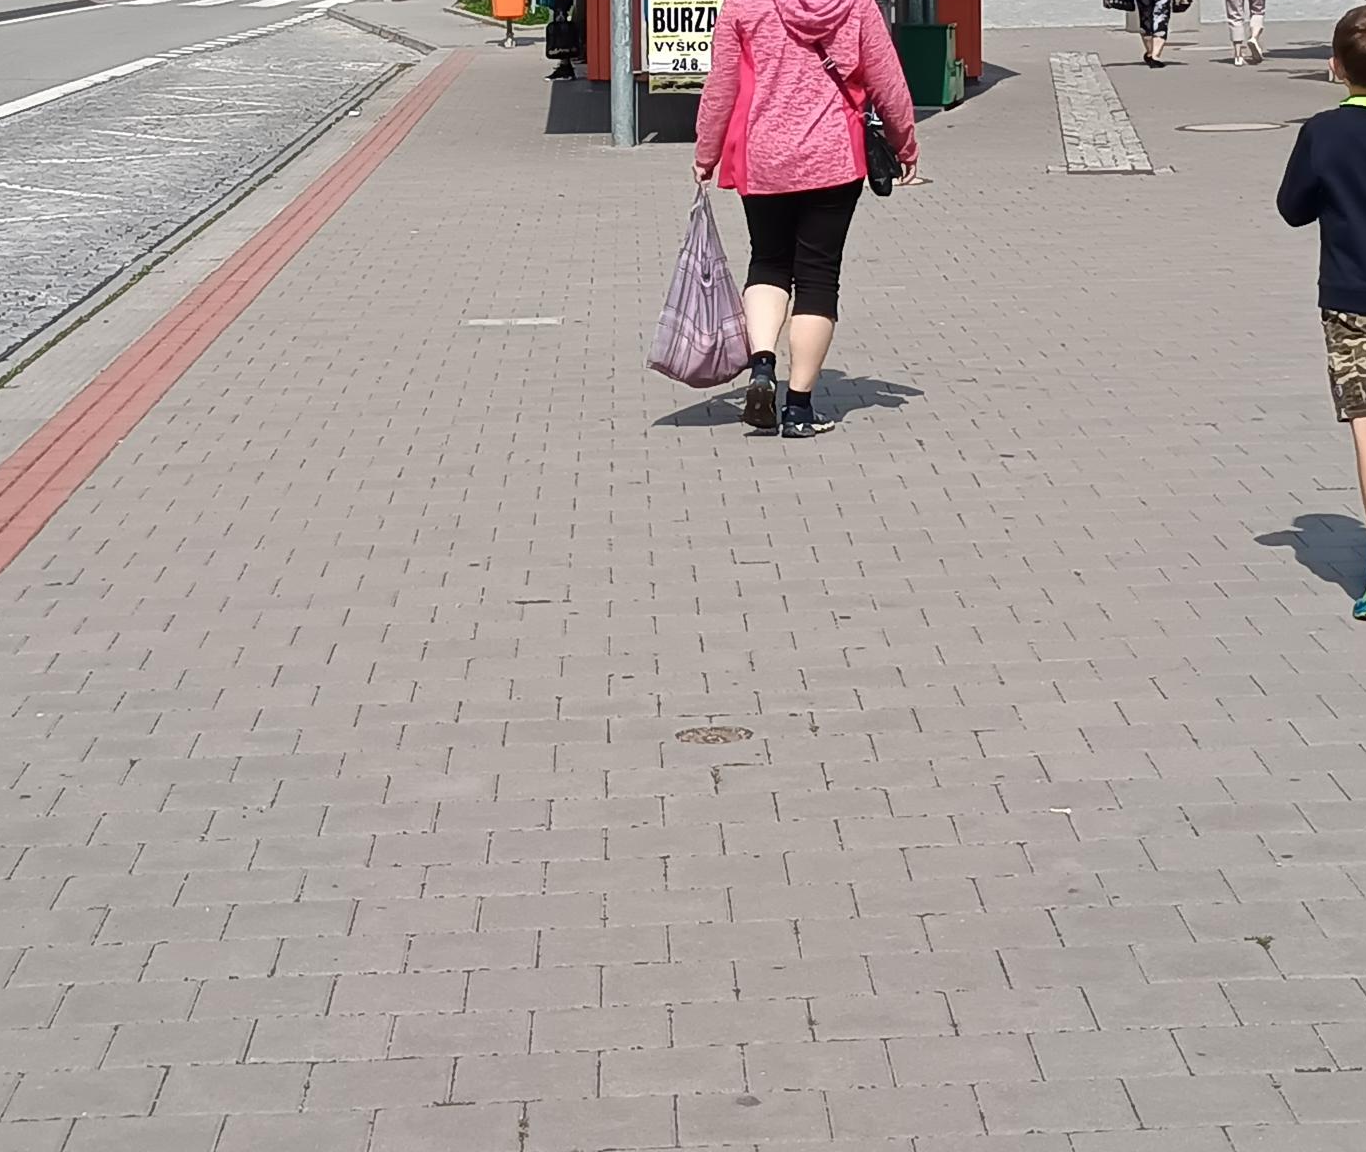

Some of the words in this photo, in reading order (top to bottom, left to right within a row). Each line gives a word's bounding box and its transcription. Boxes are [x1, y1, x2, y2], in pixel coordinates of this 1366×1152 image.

[653, 6, 718, 33] BURZA
[654, 38, 713, 52] VYŠKO
[671, 57, 702, 72] 24.8.
